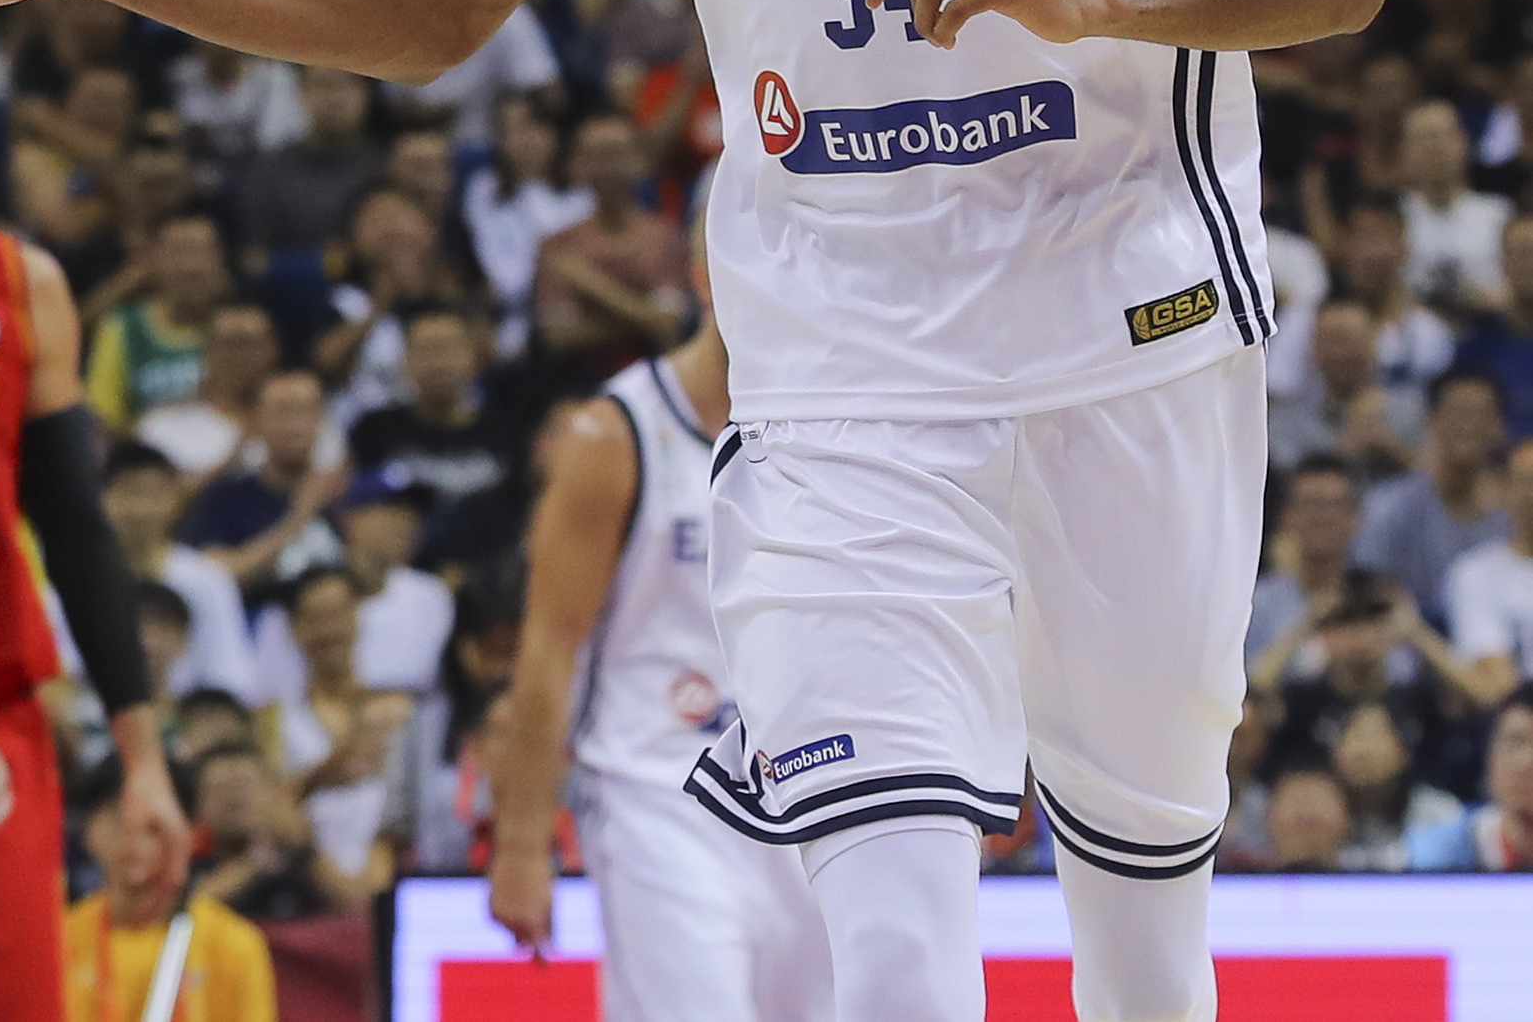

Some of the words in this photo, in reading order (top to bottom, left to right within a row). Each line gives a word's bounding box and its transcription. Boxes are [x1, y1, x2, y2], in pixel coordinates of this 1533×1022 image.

[819, 94, 1051, 162] Eurobank
[1152, 288, 1213, 326] GSA
[774, 740, 846, 779] Eurobank
